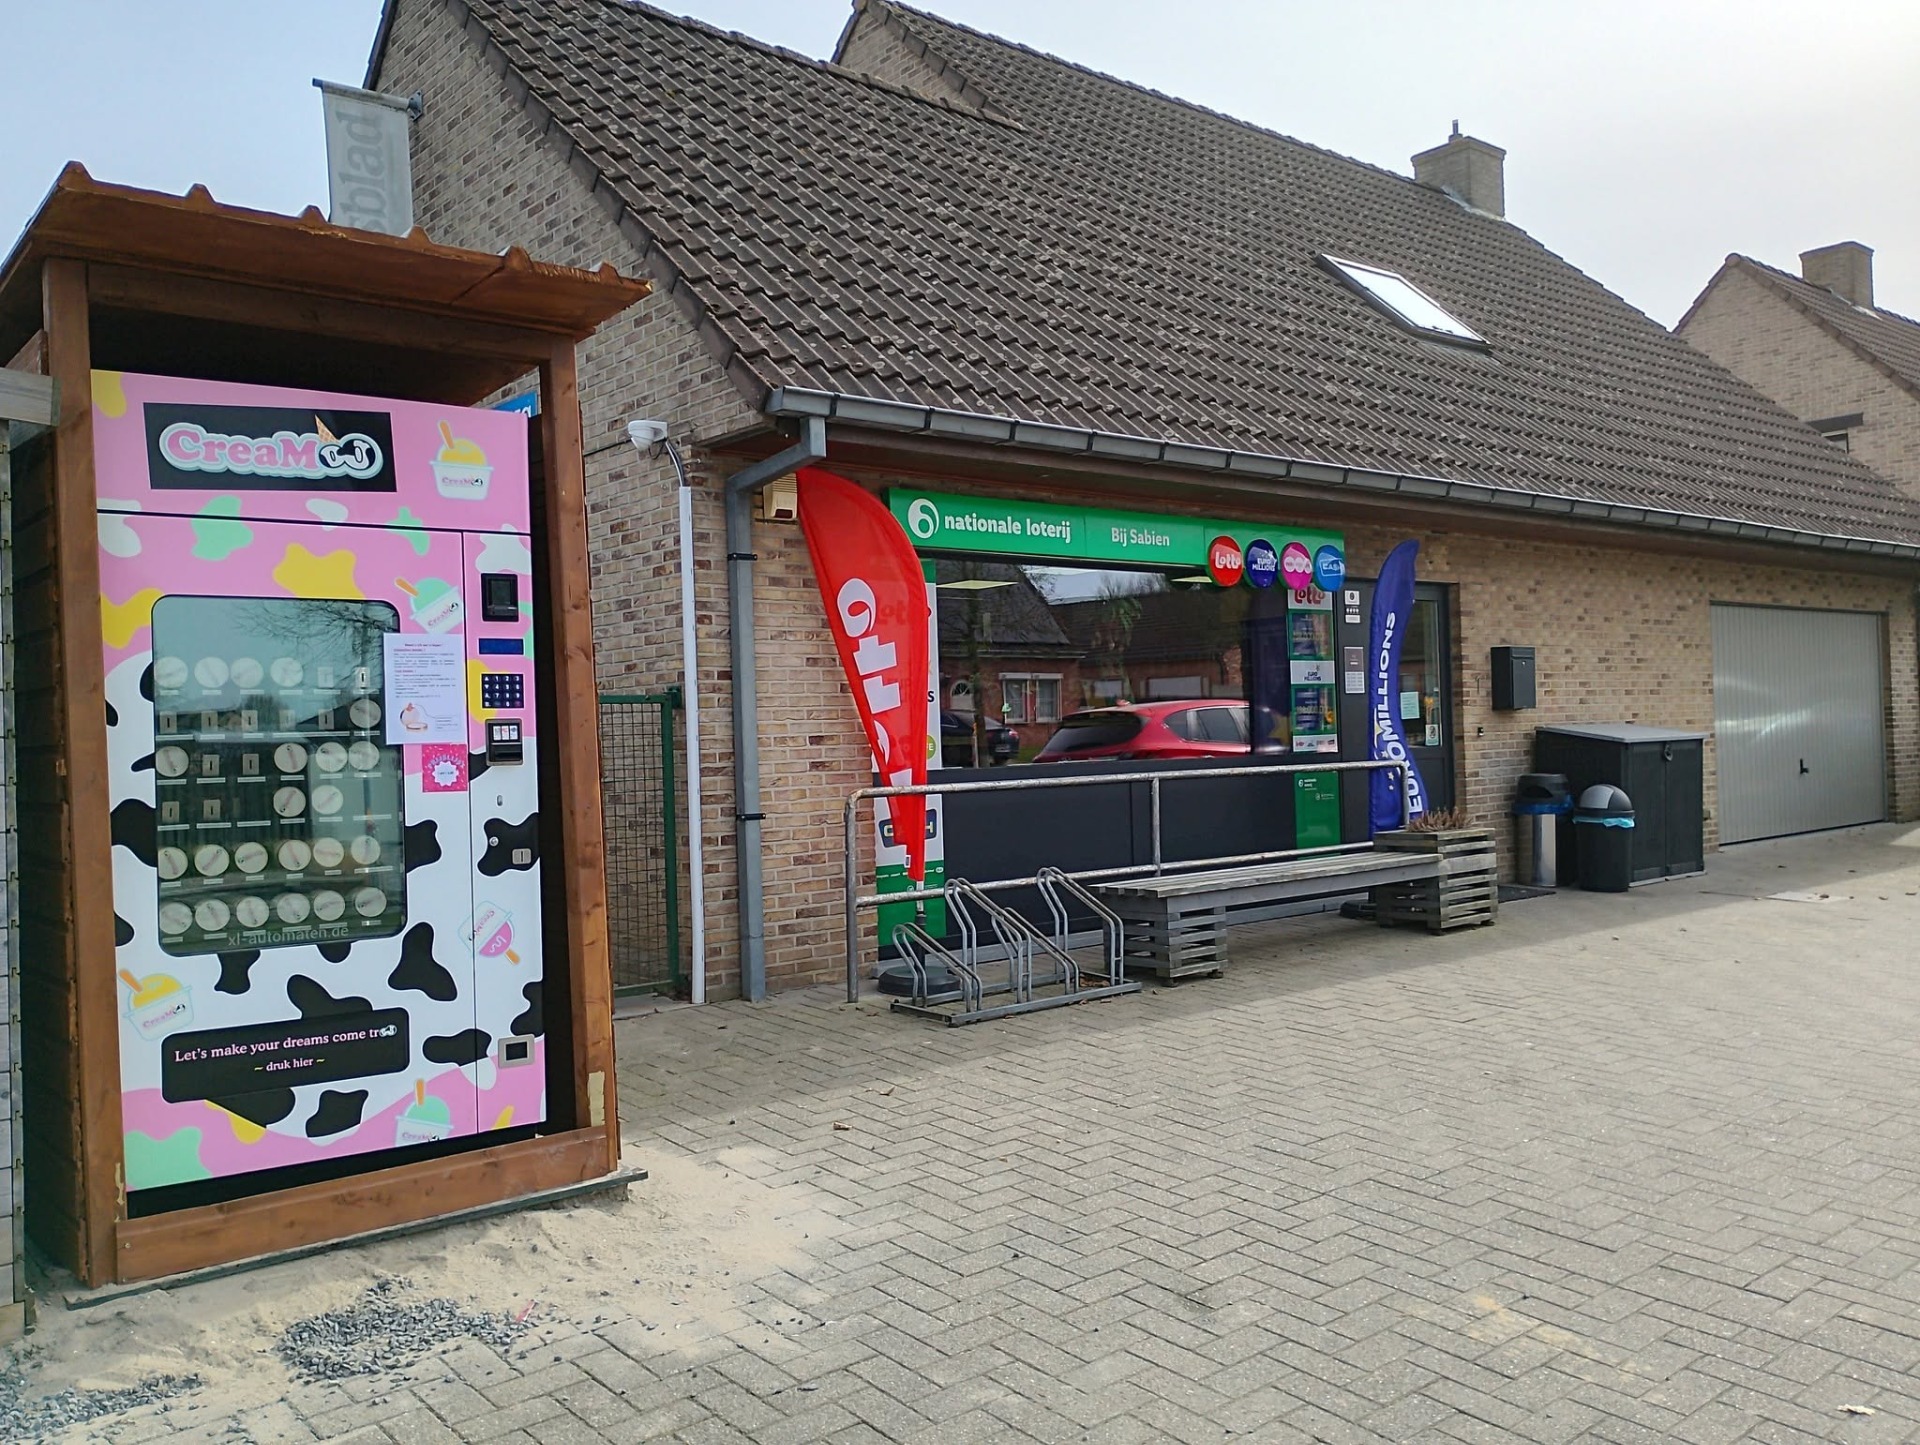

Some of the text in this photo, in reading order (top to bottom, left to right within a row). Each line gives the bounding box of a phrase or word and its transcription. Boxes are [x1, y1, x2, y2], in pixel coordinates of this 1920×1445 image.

[944, 513, 1071, 543] nationale loterij
[1111, 527, 1170, 547] Bij Sabien
[228, 926, 349, 946] xl-automaten.de
[175, 1049, 207, 1062] Let's
[211, 1043, 248, 1058] make
[249, 1041, 280, 1055] your
[283, 1035, 329, 1049] dreams
[332, 1030, 366, 1043] come
[266, 1057, 314, 1072] druk hier
